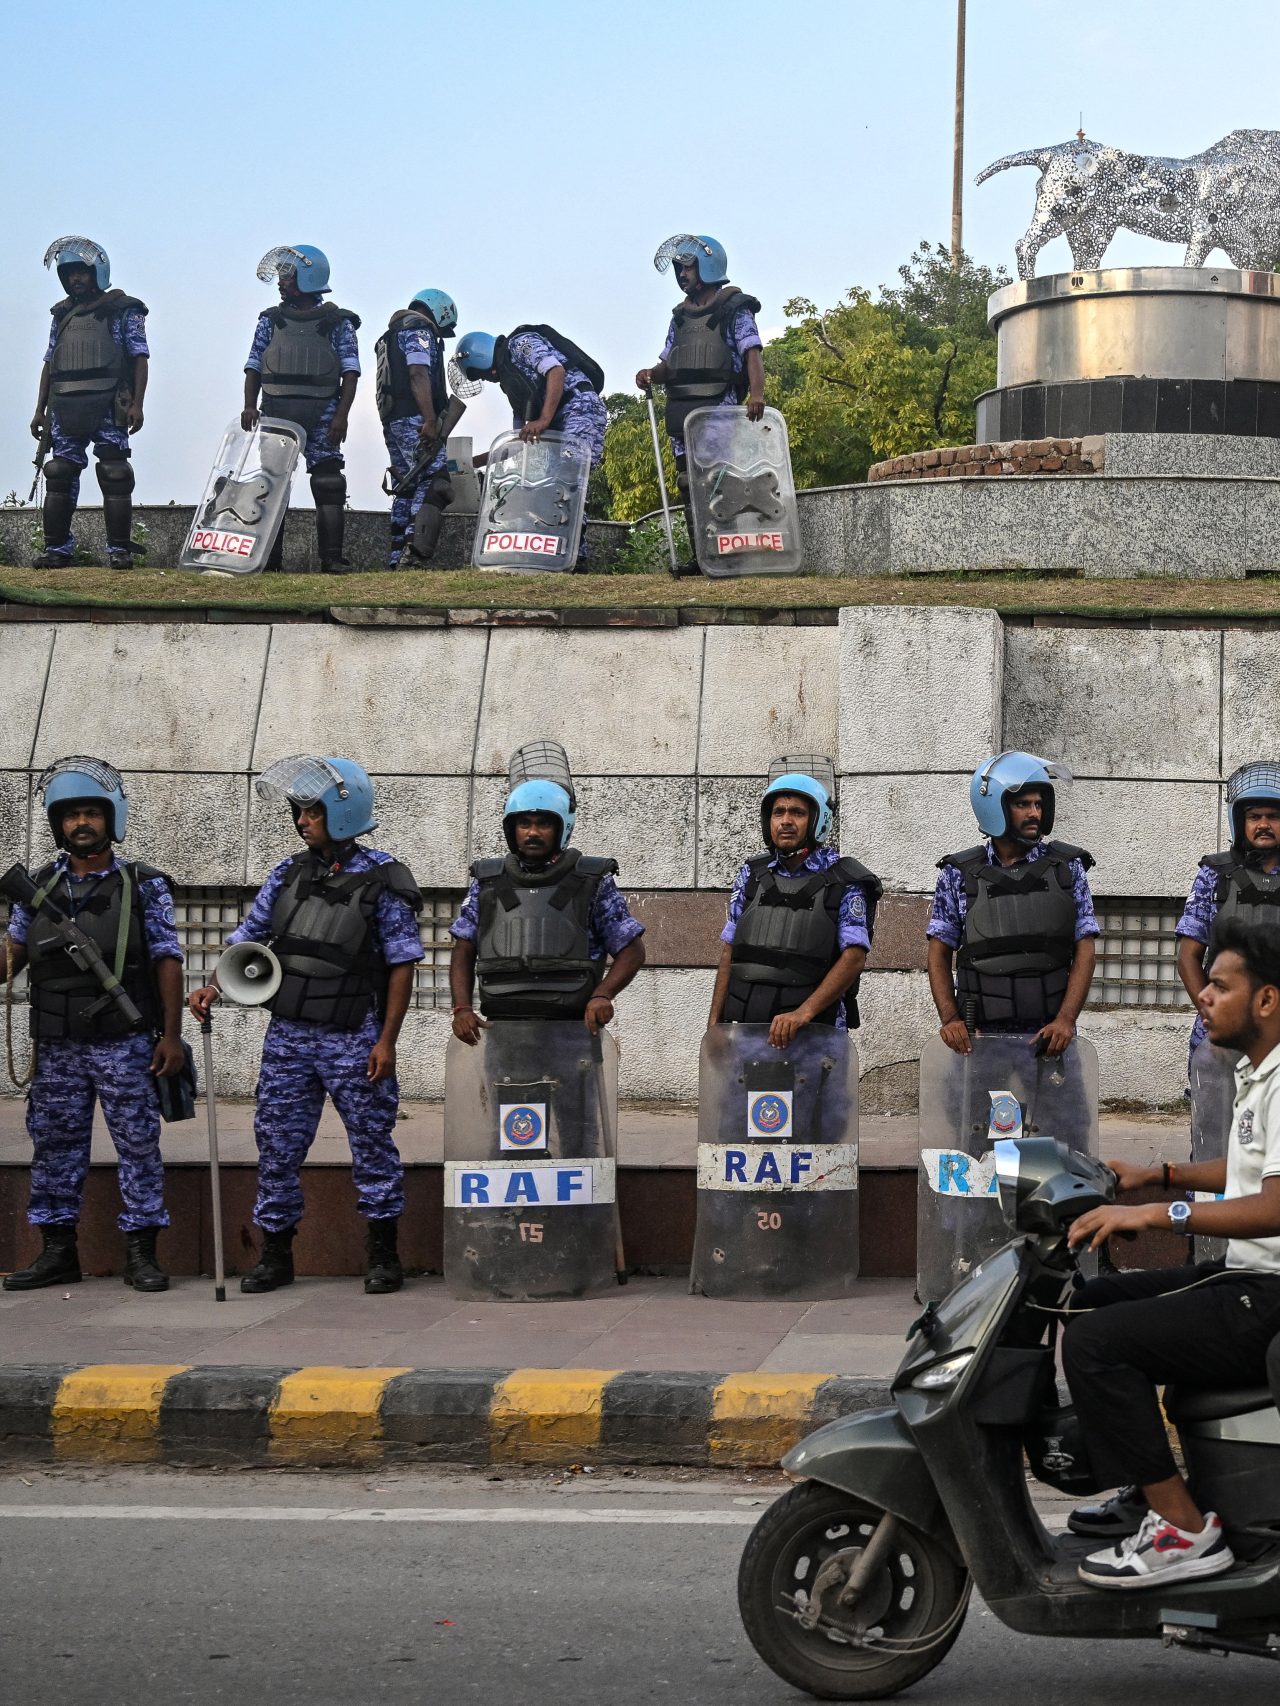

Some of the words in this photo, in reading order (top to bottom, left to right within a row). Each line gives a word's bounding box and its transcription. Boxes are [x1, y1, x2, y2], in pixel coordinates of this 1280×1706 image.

[192, 532, 253, 556] POLICE
[486, 534, 557, 554] POLICE
[724, 1150, 813, 1184] RAF
[460, 1170, 583, 1204] RAF
